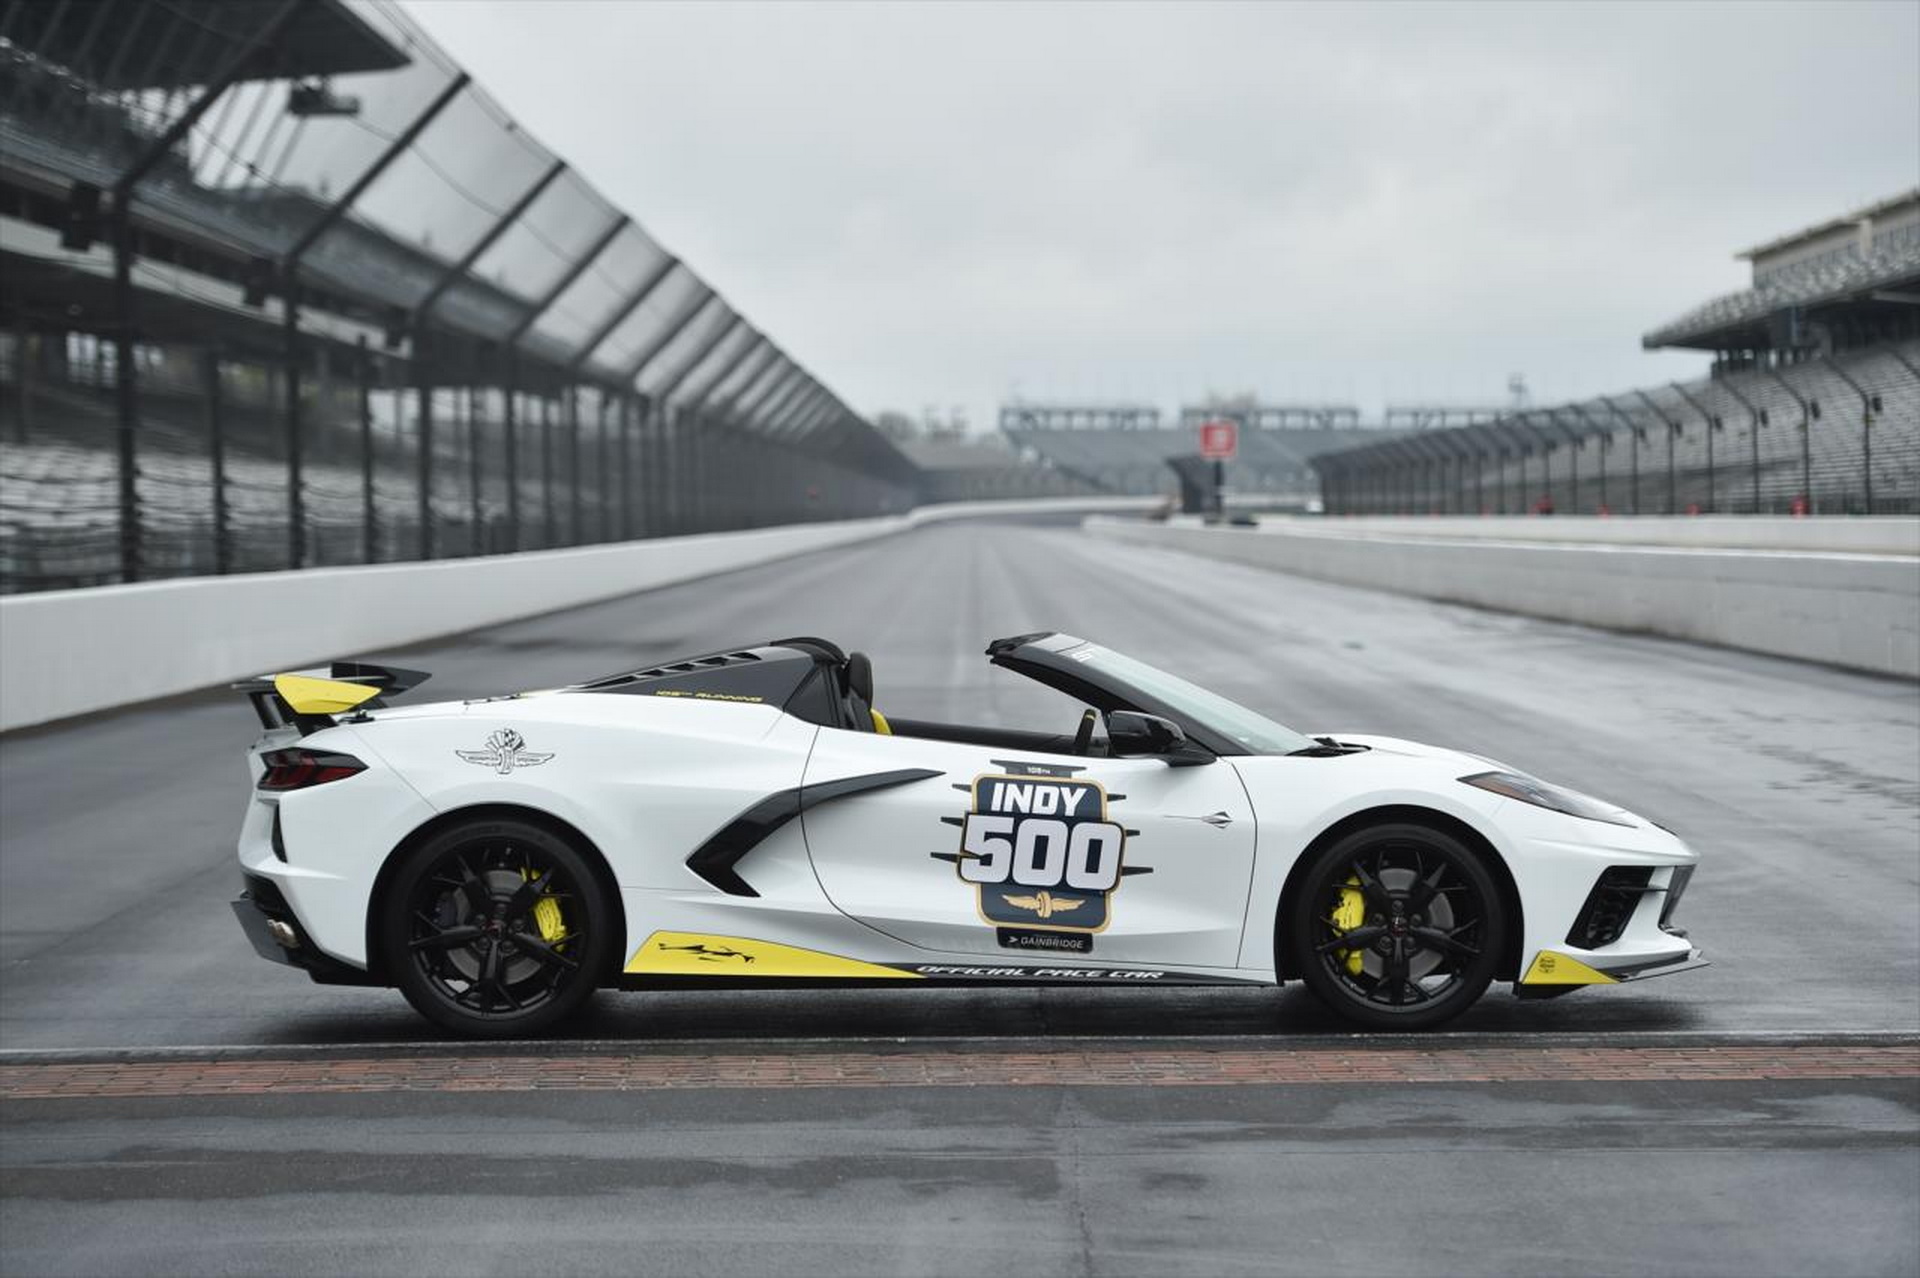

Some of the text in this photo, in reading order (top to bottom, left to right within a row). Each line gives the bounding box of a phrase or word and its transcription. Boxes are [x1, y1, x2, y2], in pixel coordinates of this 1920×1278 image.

[991, 782, 1087, 817] INDY
[960, 814, 1122, 890] 500
[1020, 936, 1084, 949] GAINBRIDGE
[917, 965, 1165, 979] OFFICIAL PACE CAR
